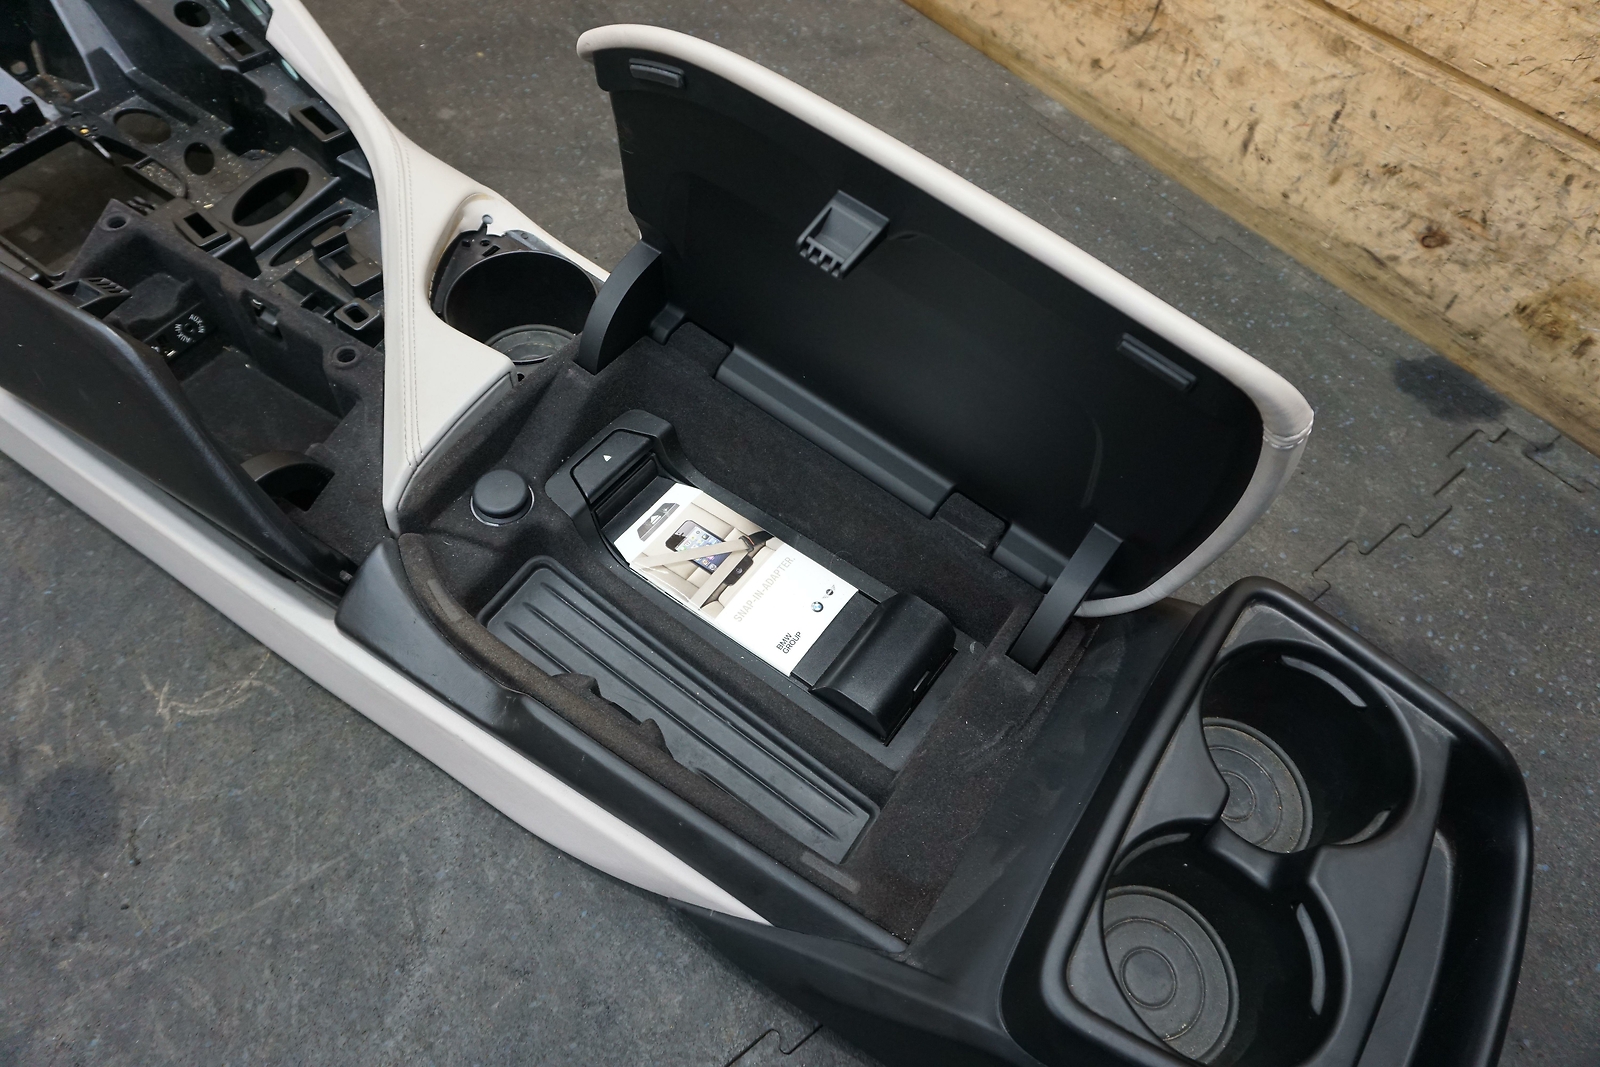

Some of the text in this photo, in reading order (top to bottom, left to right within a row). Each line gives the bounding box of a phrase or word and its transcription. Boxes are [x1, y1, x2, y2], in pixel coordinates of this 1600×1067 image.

[188, 314, 205, 333] AUX-IN
[733, 556, 796, 622] SNAP-IN-ADAPTER.
[776, 632, 793, 651] BMW
[782, 631, 802, 654] GROUP
